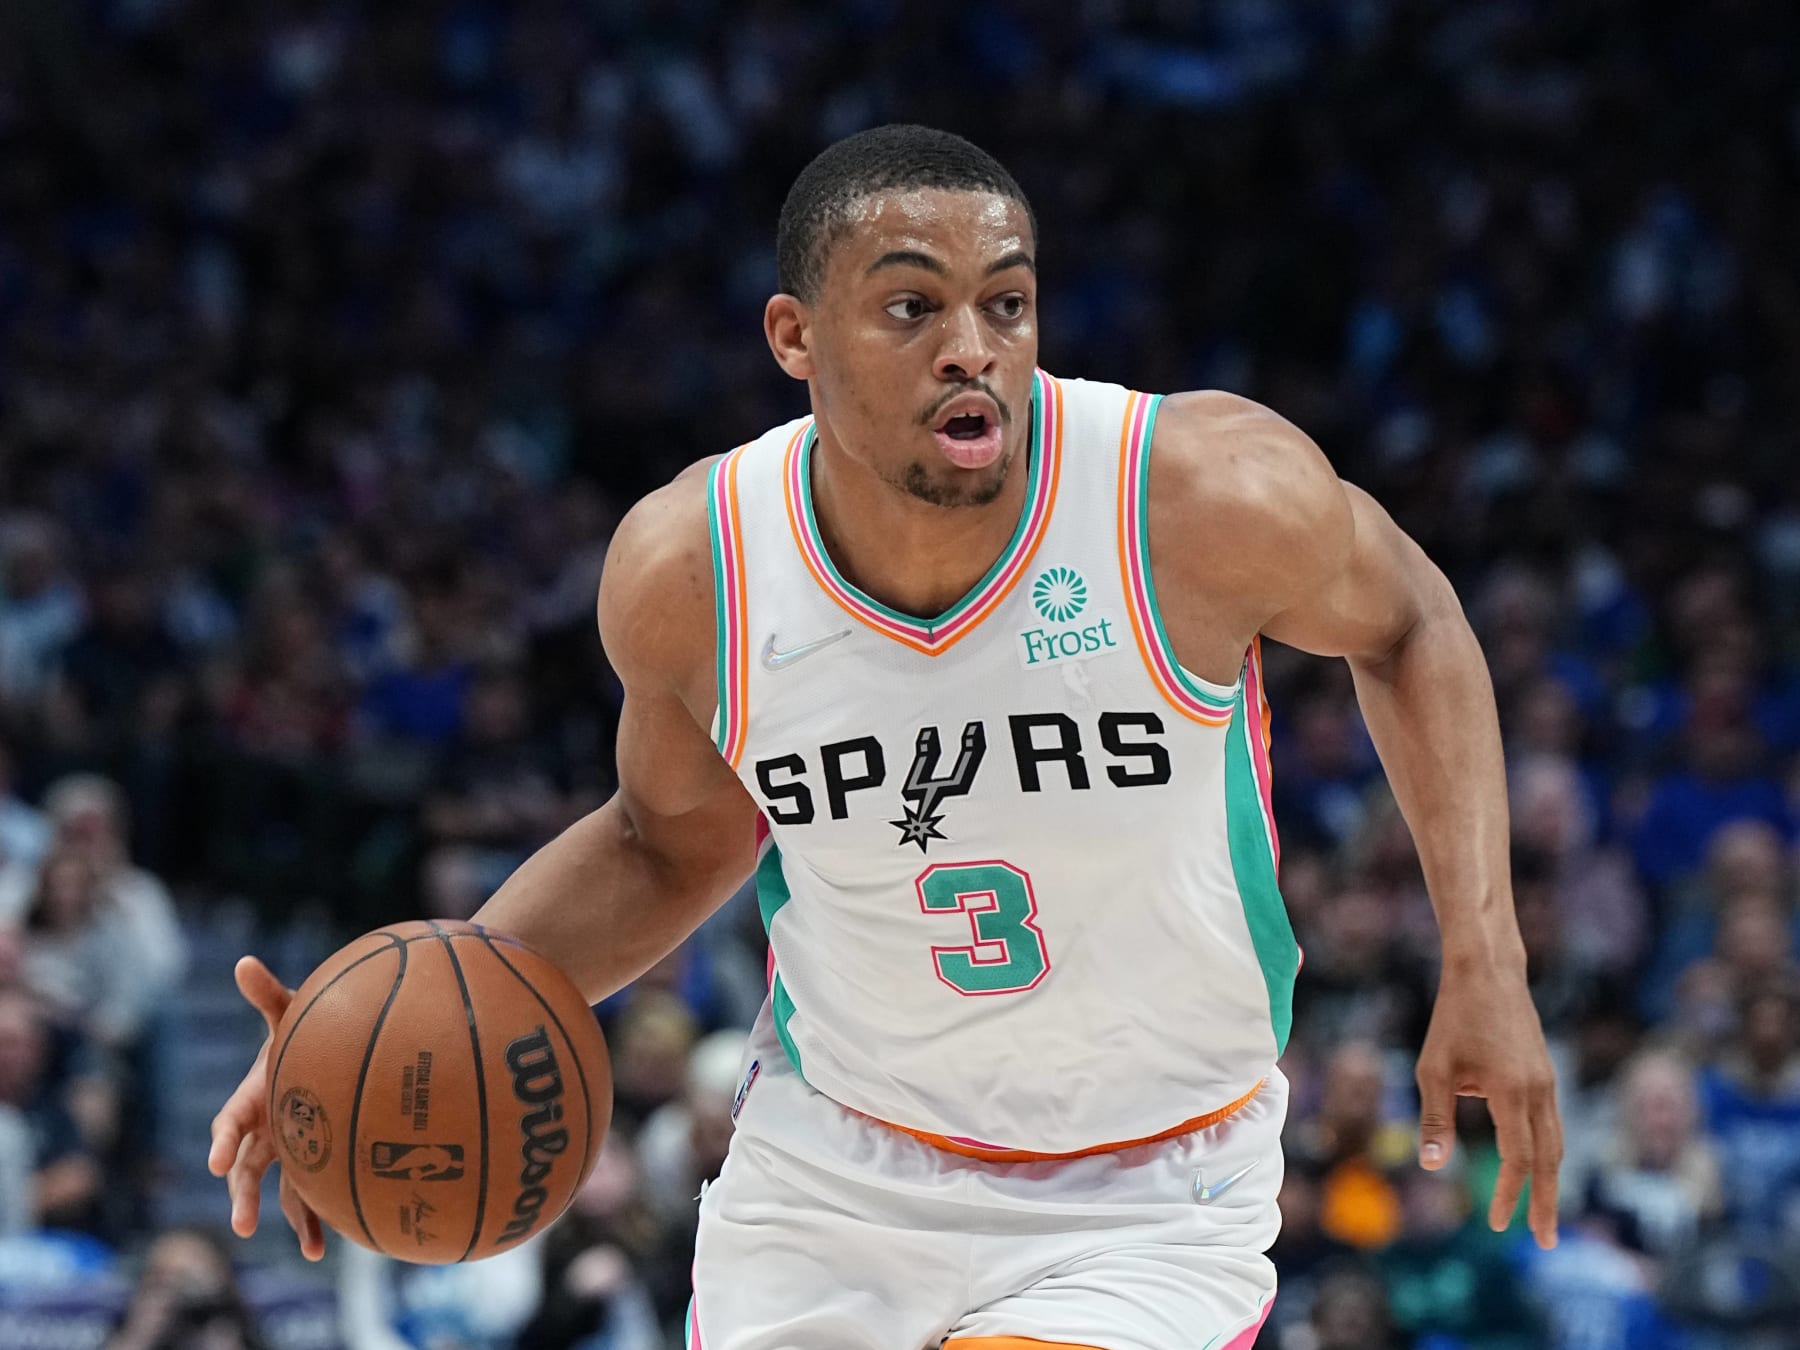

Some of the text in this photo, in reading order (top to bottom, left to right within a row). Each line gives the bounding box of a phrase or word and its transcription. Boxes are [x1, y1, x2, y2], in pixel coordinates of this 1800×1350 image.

[1020, 618, 1116, 664] Frost
[756, 712, 1171, 854] SPURS
[915, 860, 1050, 996] 3
[413, 1051, 432, 1131] OFFICIAL GAME BALL
[495, 1024, 569, 1246] Wilson
